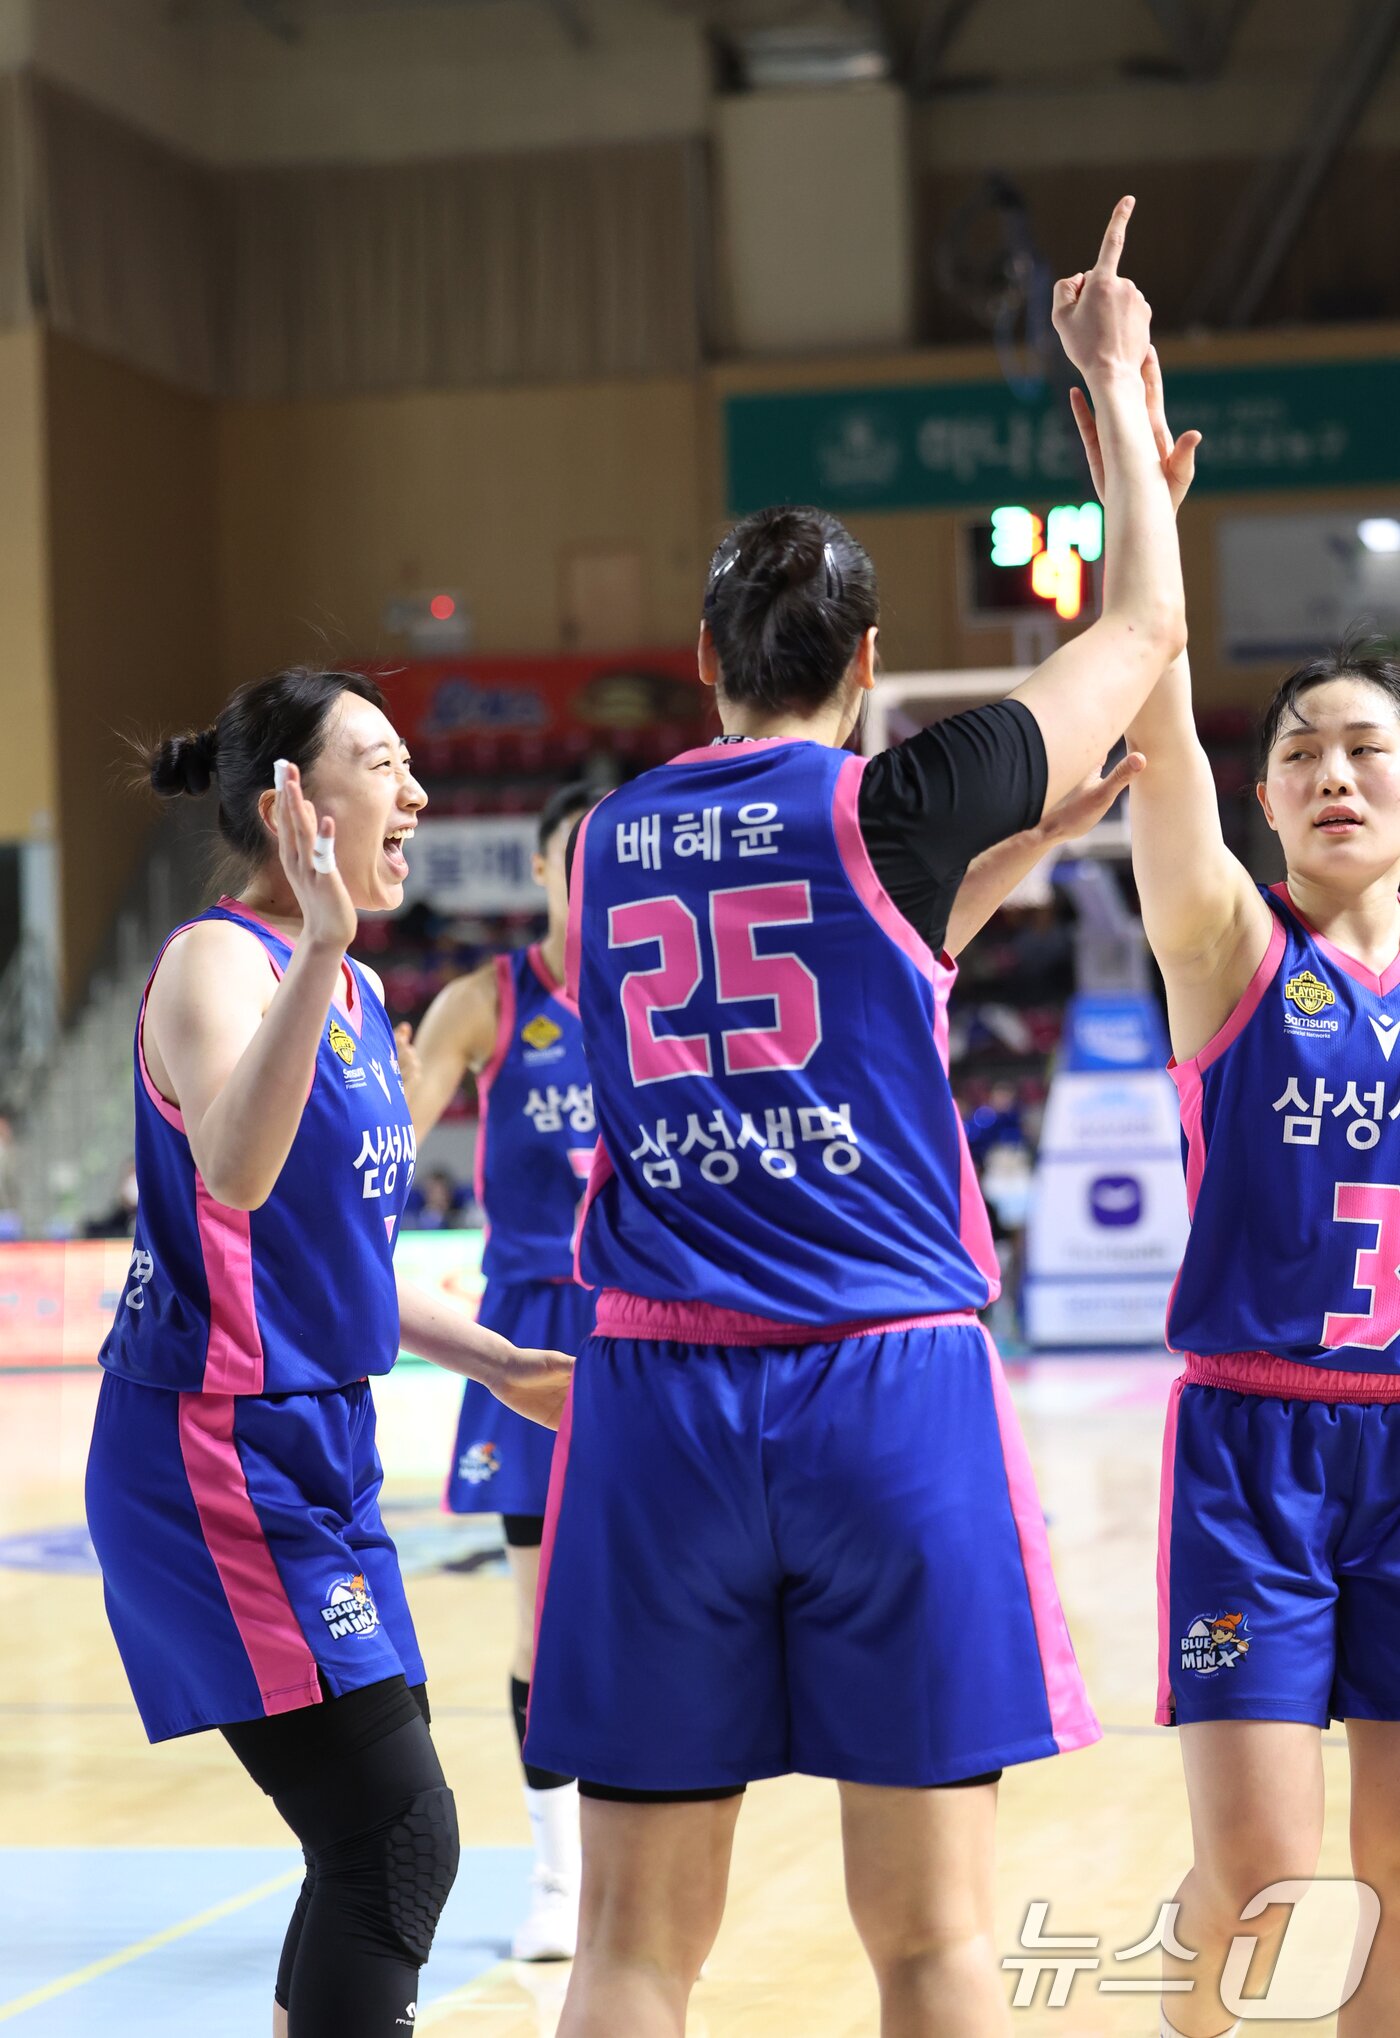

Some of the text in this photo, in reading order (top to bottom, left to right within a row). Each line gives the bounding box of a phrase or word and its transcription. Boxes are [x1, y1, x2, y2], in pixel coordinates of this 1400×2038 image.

[616, 802, 784, 870] 배혜윤
[608, 880, 823, 1087] 25
[1288, 985, 1333, 1002] PLAYOFFS
[1284, 1013, 1339, 1032] Samsung
[1272, 1077, 1400, 1150] 삼성
[630, 1103, 861, 1189] 삼성생명
[320, 1600, 361, 1621] BLUE
[1181, 1637, 1212, 1650] BLUE
